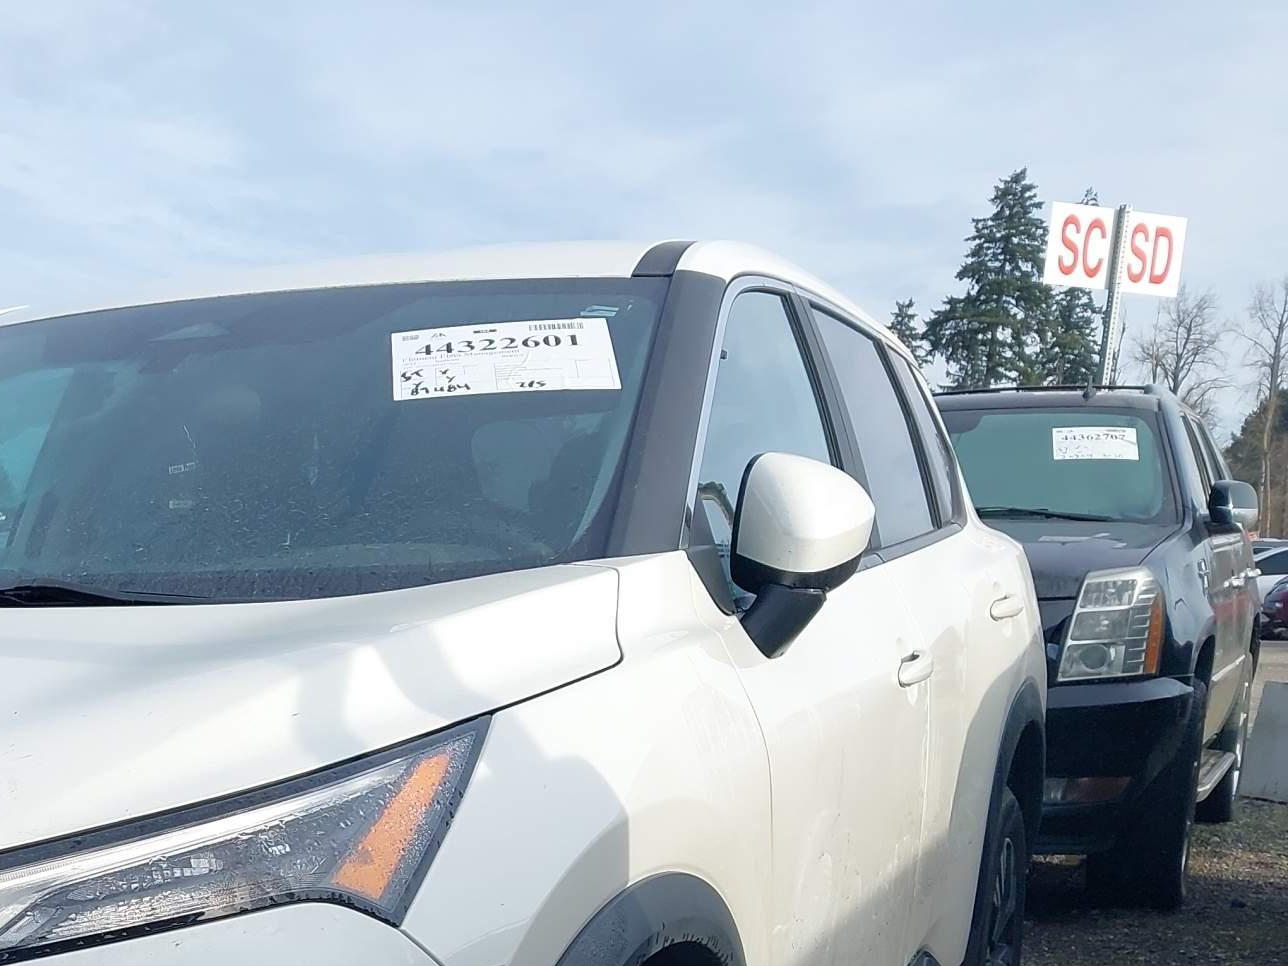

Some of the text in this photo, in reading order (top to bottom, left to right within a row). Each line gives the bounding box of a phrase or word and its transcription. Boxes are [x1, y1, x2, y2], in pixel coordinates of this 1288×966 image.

[1058, 214, 1107, 278] SC
[1127, 222, 1173, 285] SD
[415, 333, 581, 356] 44322601
